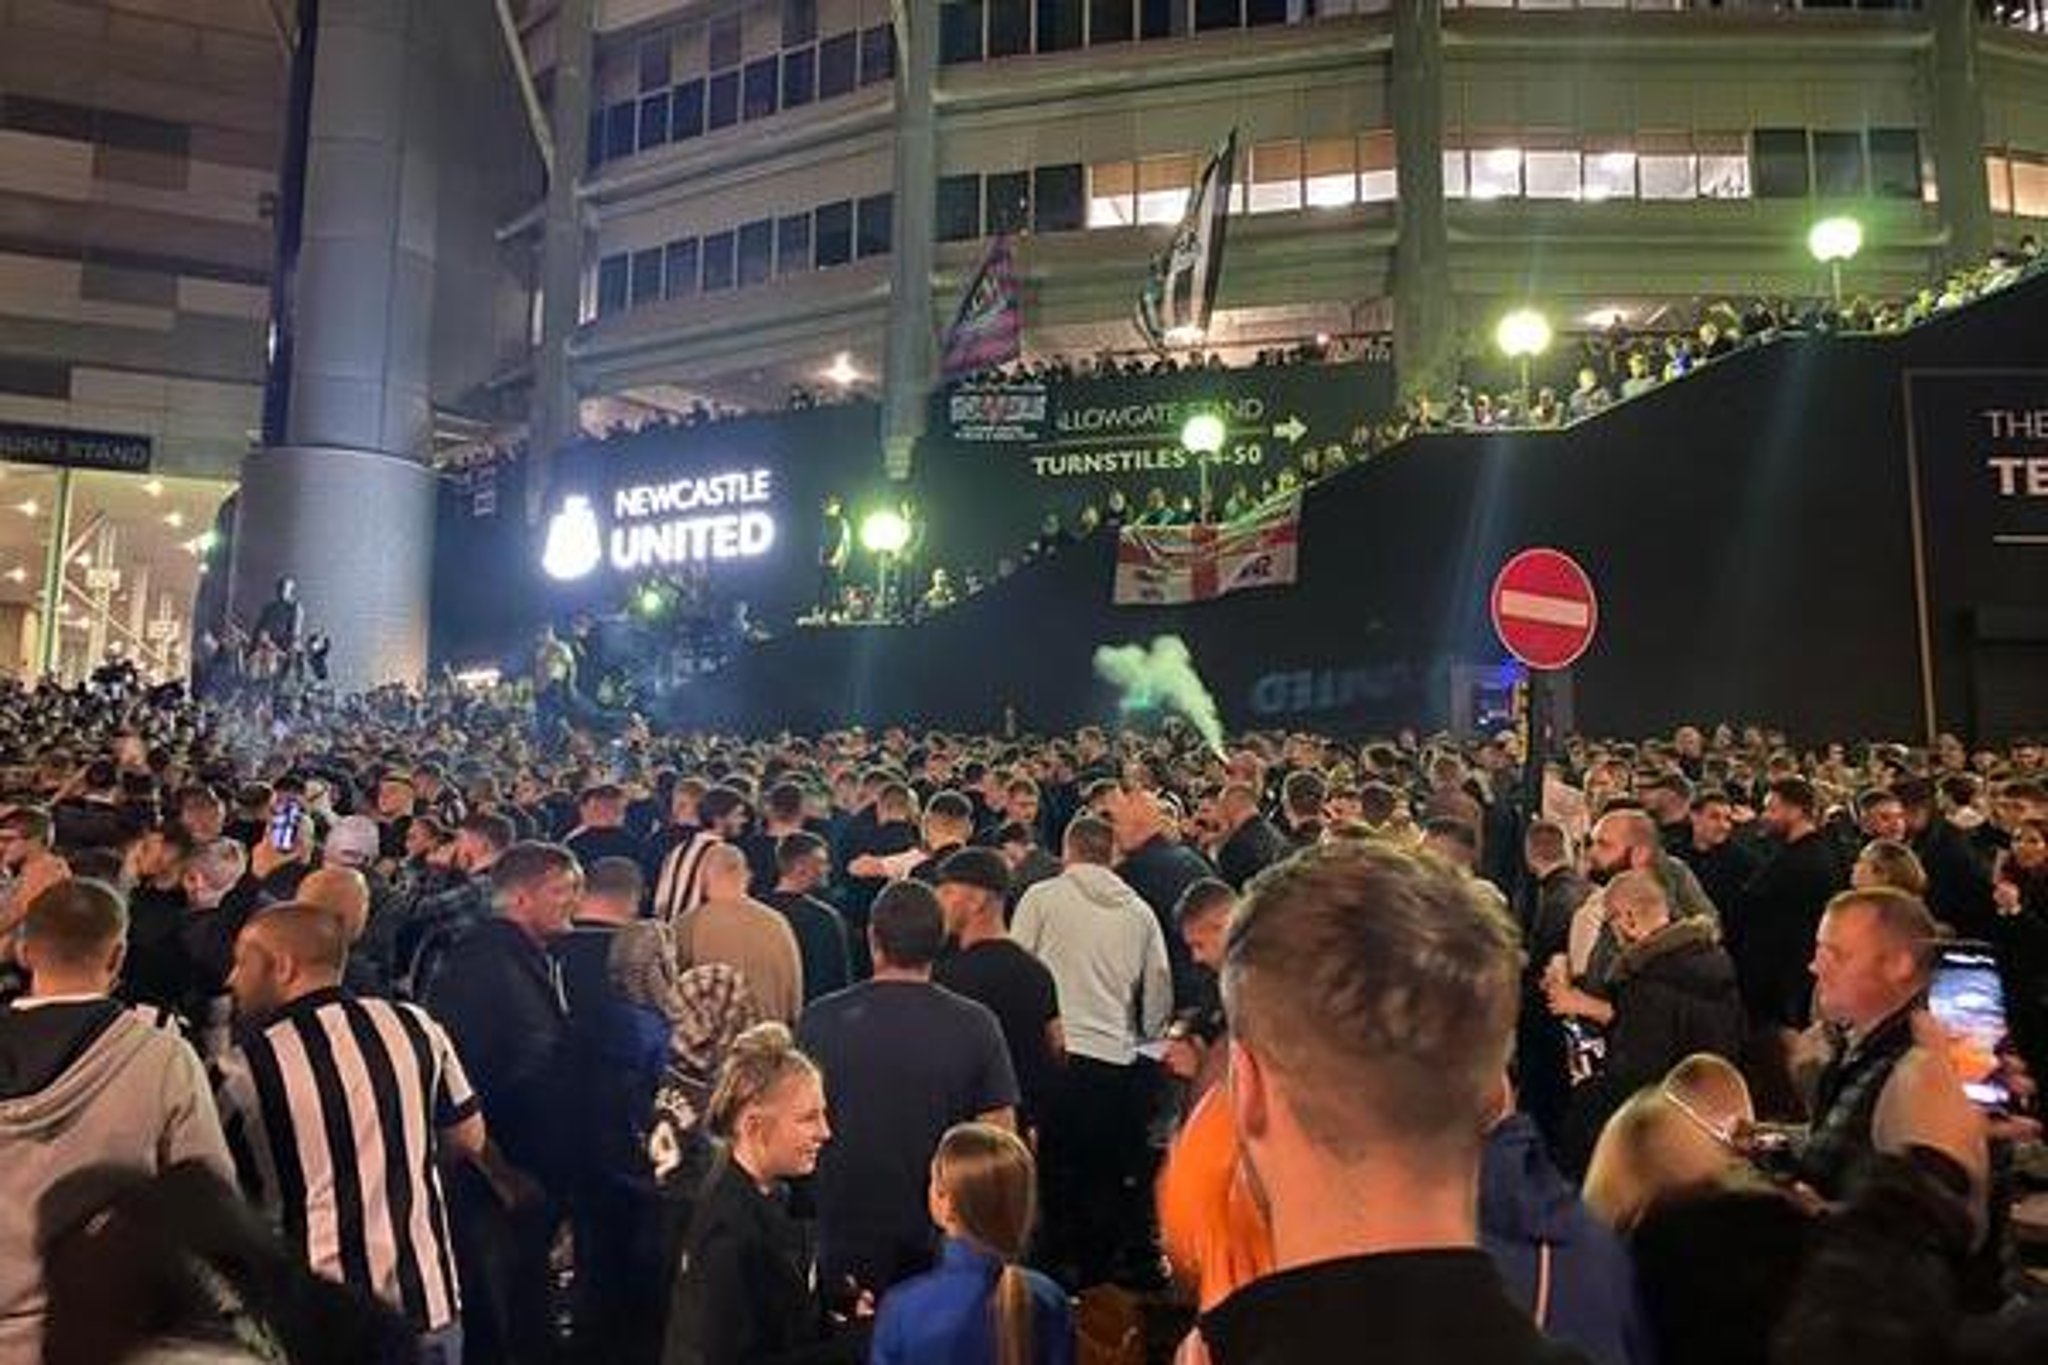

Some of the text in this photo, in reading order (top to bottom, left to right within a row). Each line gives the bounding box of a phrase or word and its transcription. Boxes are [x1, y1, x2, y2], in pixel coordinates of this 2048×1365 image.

[1057, 402, 1179, 430] LLOWGATE
[1982, 410, 2048, 437] THE
[1032, 443, 1262, 475] TURNSTILES 4-50
[615, 468, 771, 518] NEWCASTLE
[610, 510, 776, 568] UNITED
